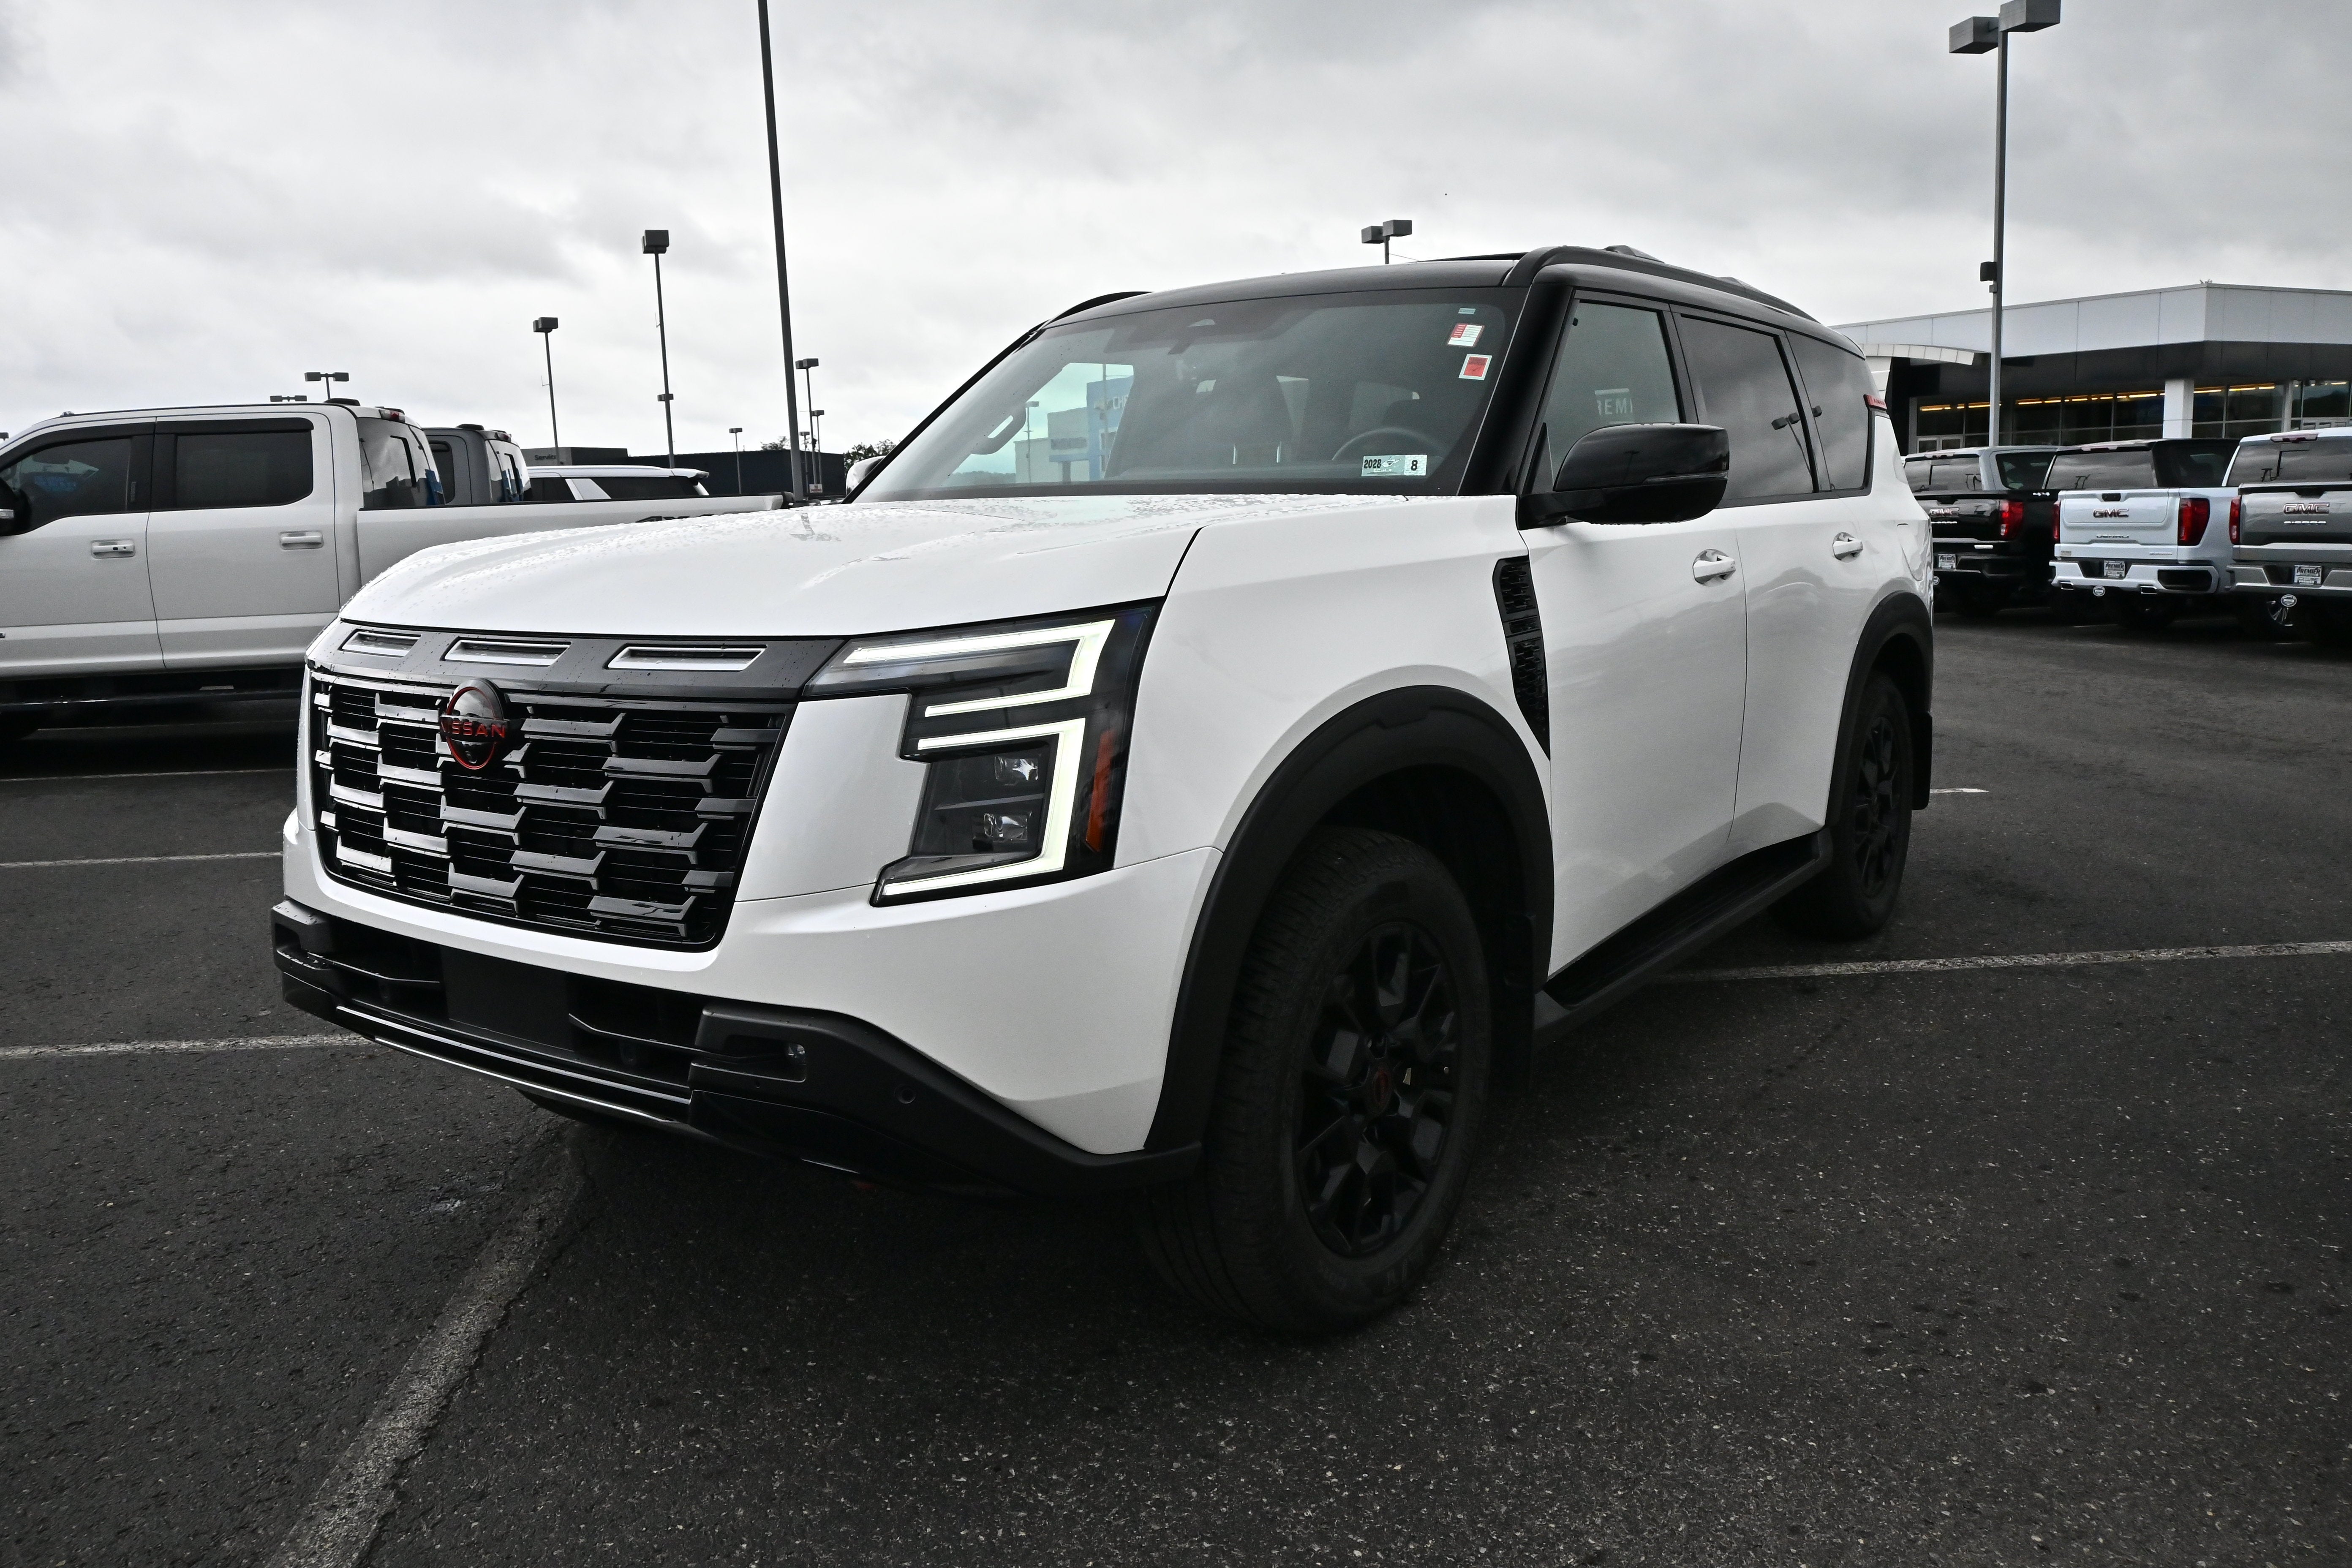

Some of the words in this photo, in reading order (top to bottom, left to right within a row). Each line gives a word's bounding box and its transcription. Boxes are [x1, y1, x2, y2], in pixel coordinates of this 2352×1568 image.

[1364, 459, 1382, 468] 2028
[1410, 460, 1418, 471] 8
[1929, 508, 1960, 517] GMC
[2093, 508, 2129, 518] GMC
[2283, 502, 2330, 515] GMC
[2297, 566, 2321, 576] PREMIER
